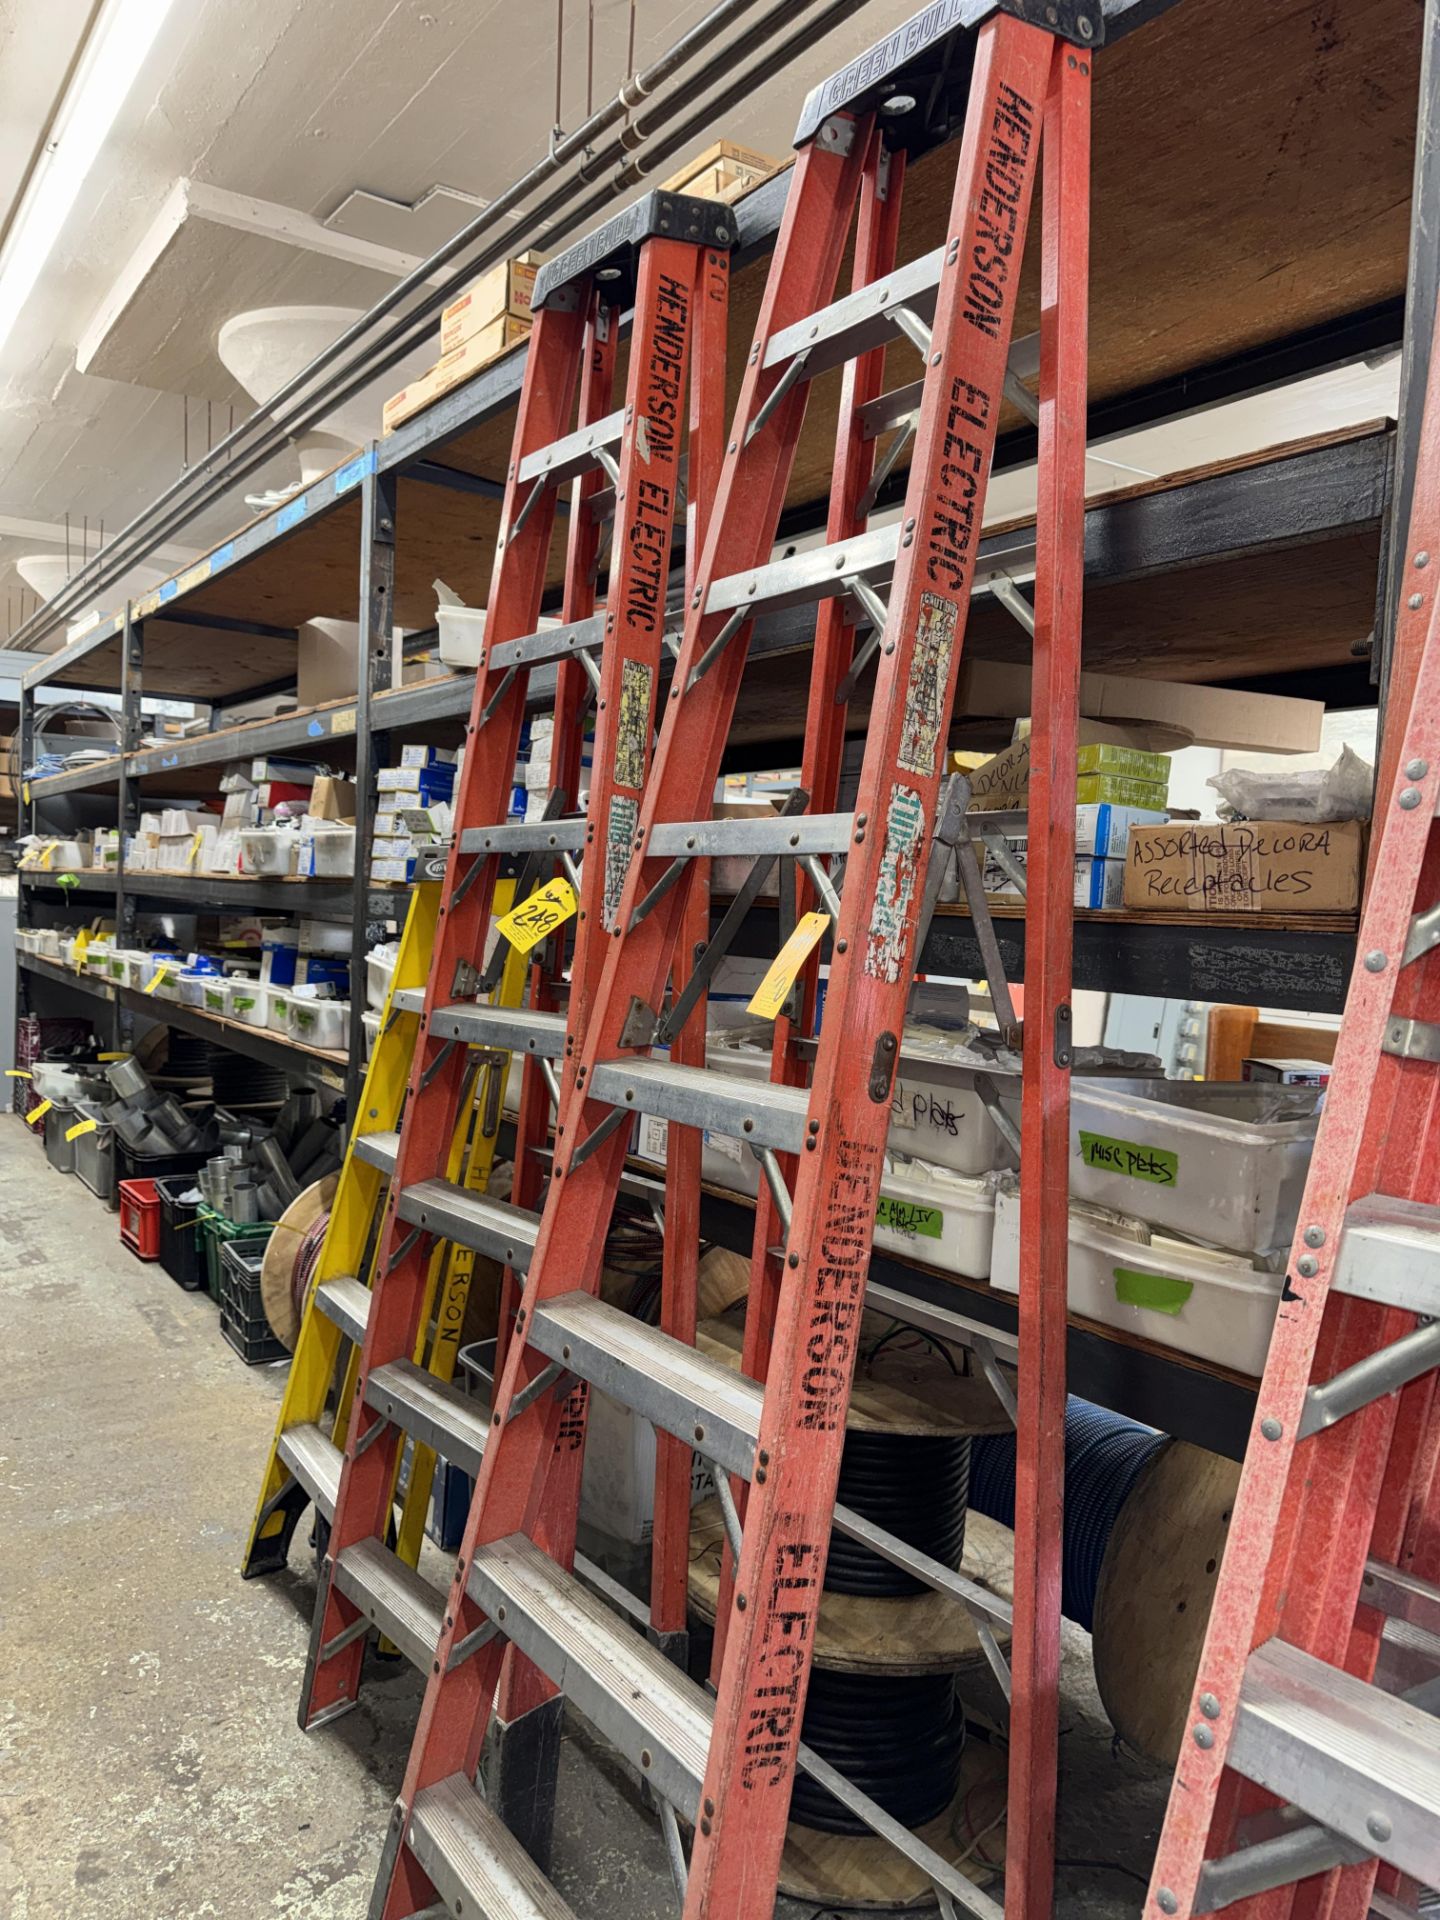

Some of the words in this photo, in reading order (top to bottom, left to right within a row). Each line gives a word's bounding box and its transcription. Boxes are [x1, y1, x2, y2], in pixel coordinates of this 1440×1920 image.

[829, 33, 900, 107] GREEN
[902, 1, 962, 60] BULL
[963, 82, 1034, 340] HENDERSON
[646, 273, 690, 462] HENDERSON
[626, 480, 670, 632] ELECTRIC
[928, 376, 990, 590] ELECTRIC
[796, 1140, 878, 1431] HENDERSON
[742, 1543, 821, 1790] ELECTRIC
